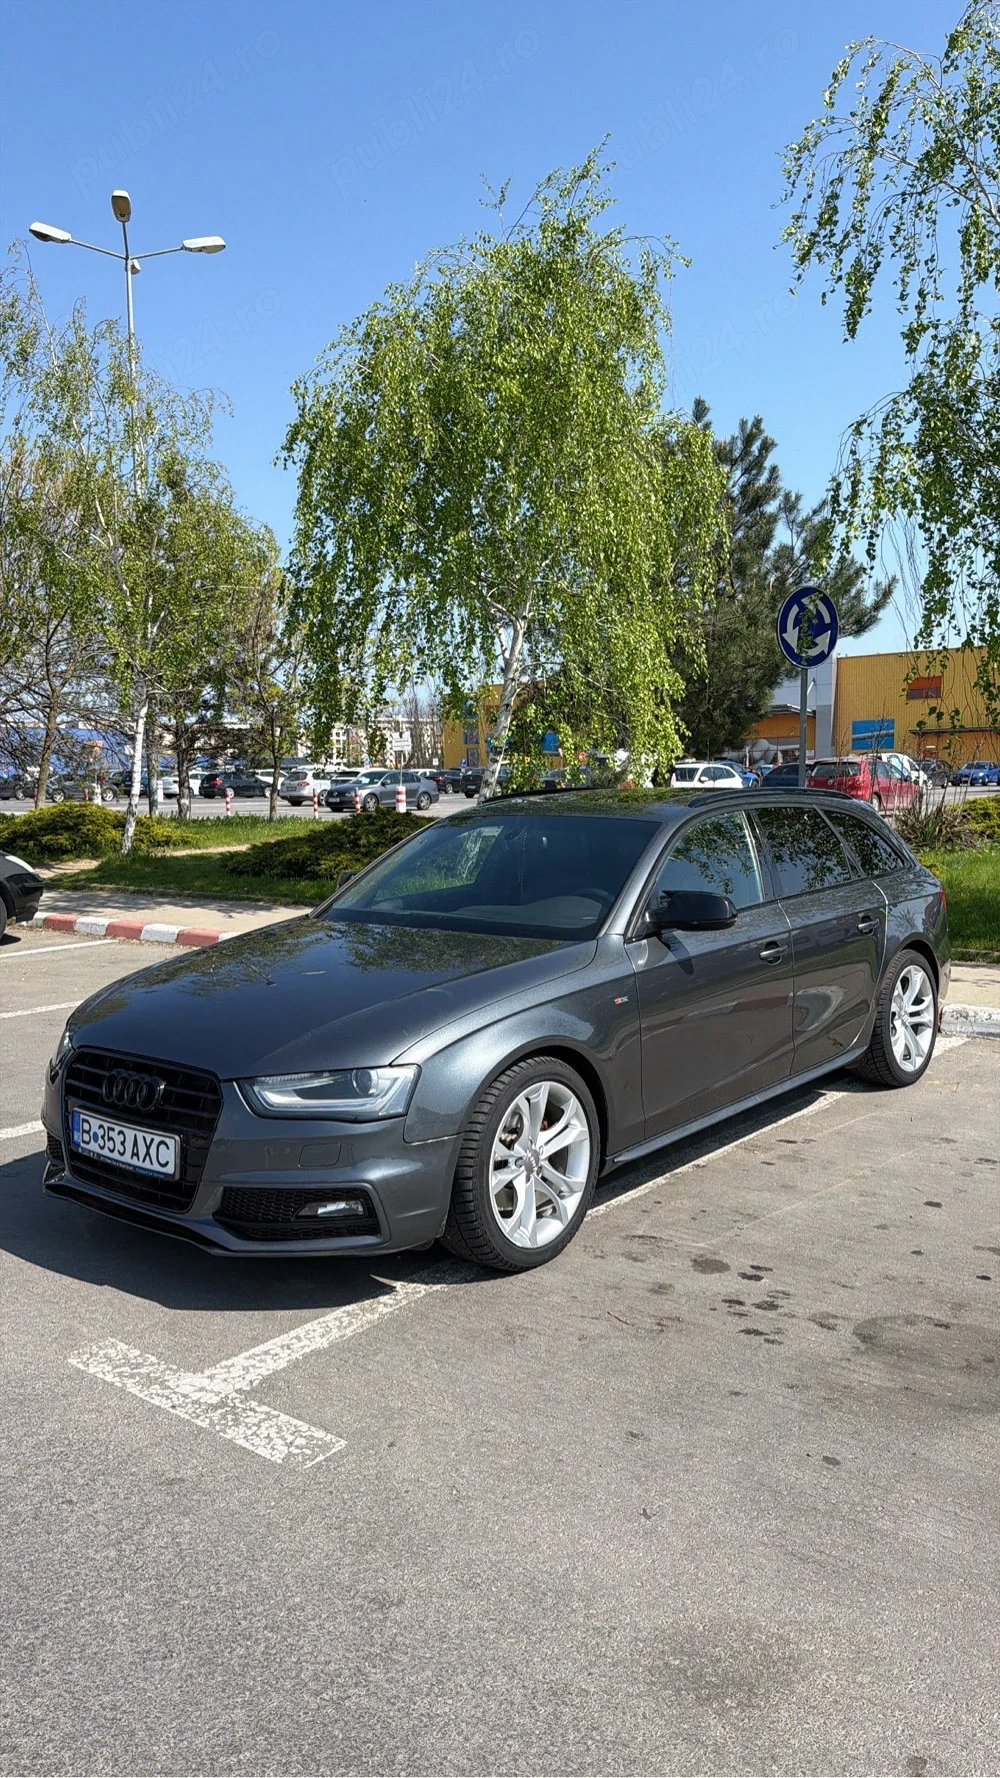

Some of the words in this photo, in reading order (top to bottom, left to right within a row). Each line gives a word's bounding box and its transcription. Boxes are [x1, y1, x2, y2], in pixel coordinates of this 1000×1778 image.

[81, 1118, 92, 1146] B
[98, 1123, 126, 1157] 353
[130, 1133, 170, 1168] AXC
